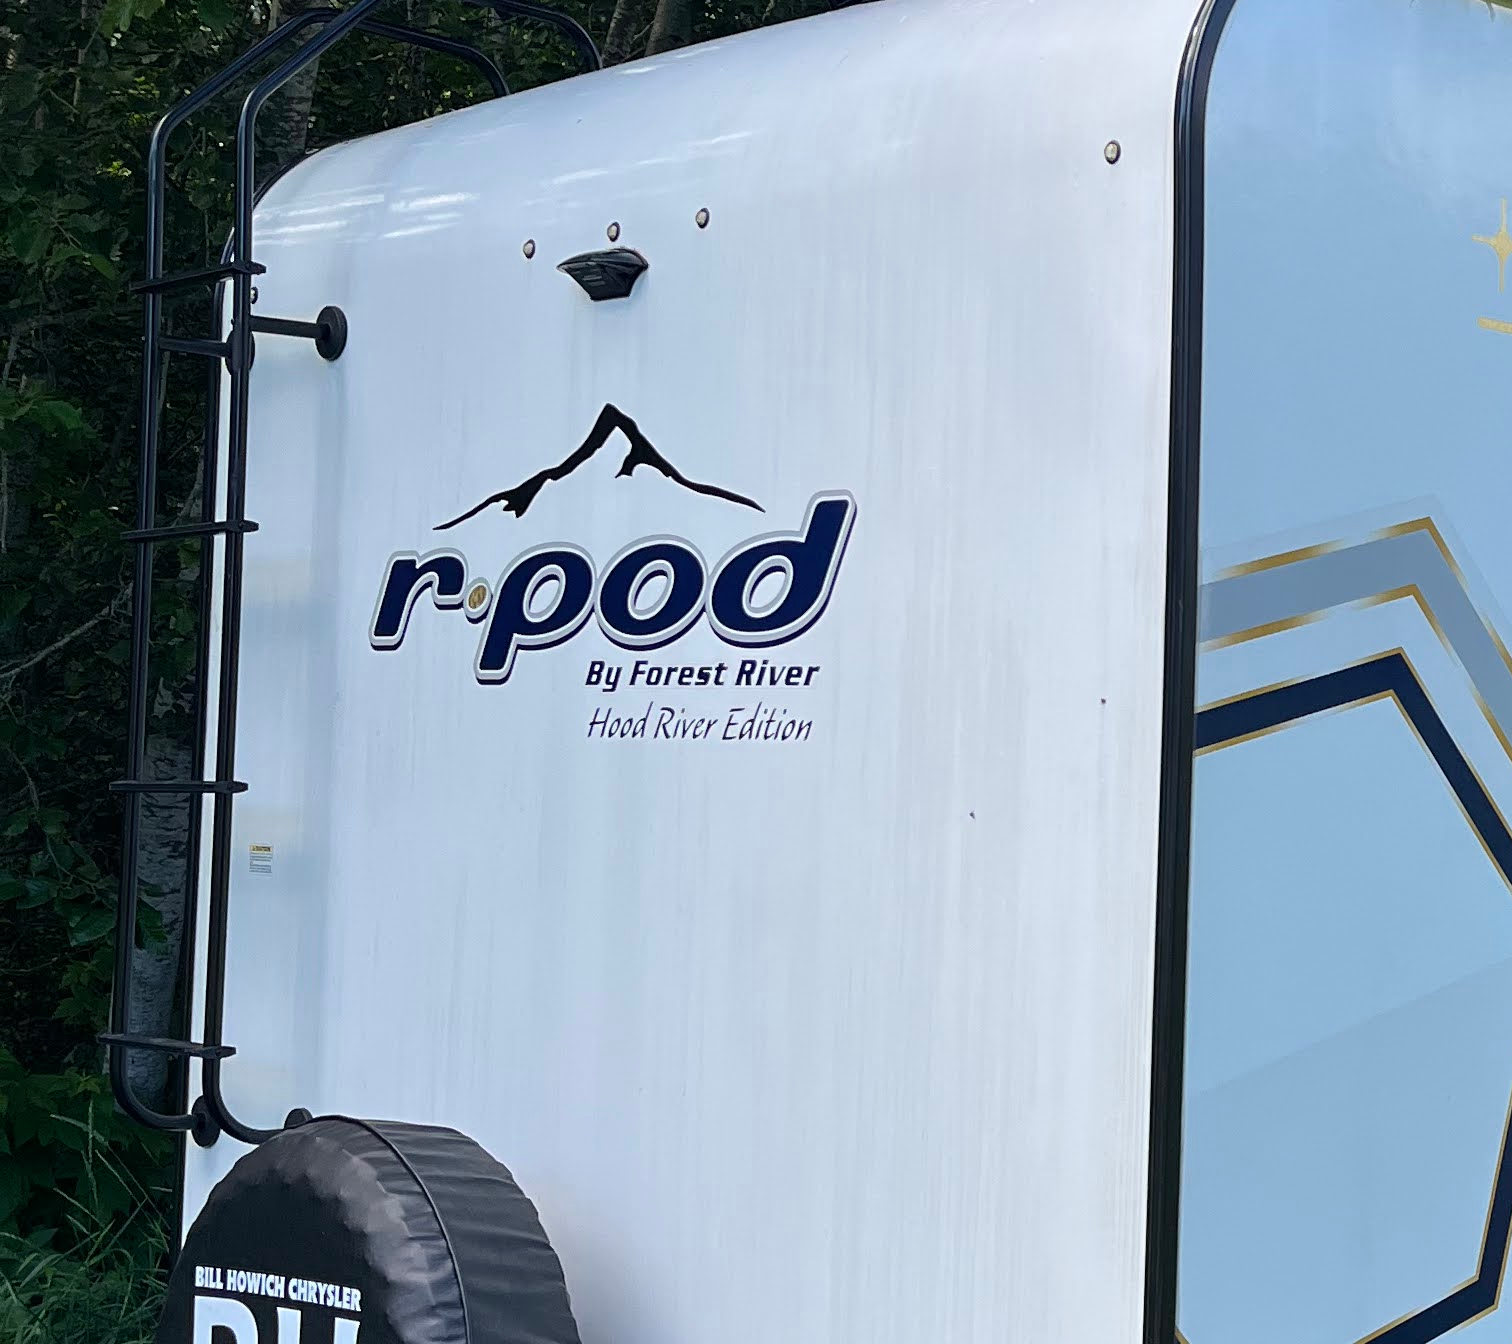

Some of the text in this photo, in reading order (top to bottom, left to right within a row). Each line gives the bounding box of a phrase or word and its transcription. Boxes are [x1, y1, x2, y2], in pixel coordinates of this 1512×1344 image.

[585, 659, 820, 692] By Forest River
[588, 701, 812, 741] Hood River Edition
[195, 1266, 361, 1312] BILL HOWICH CHRYSLER
